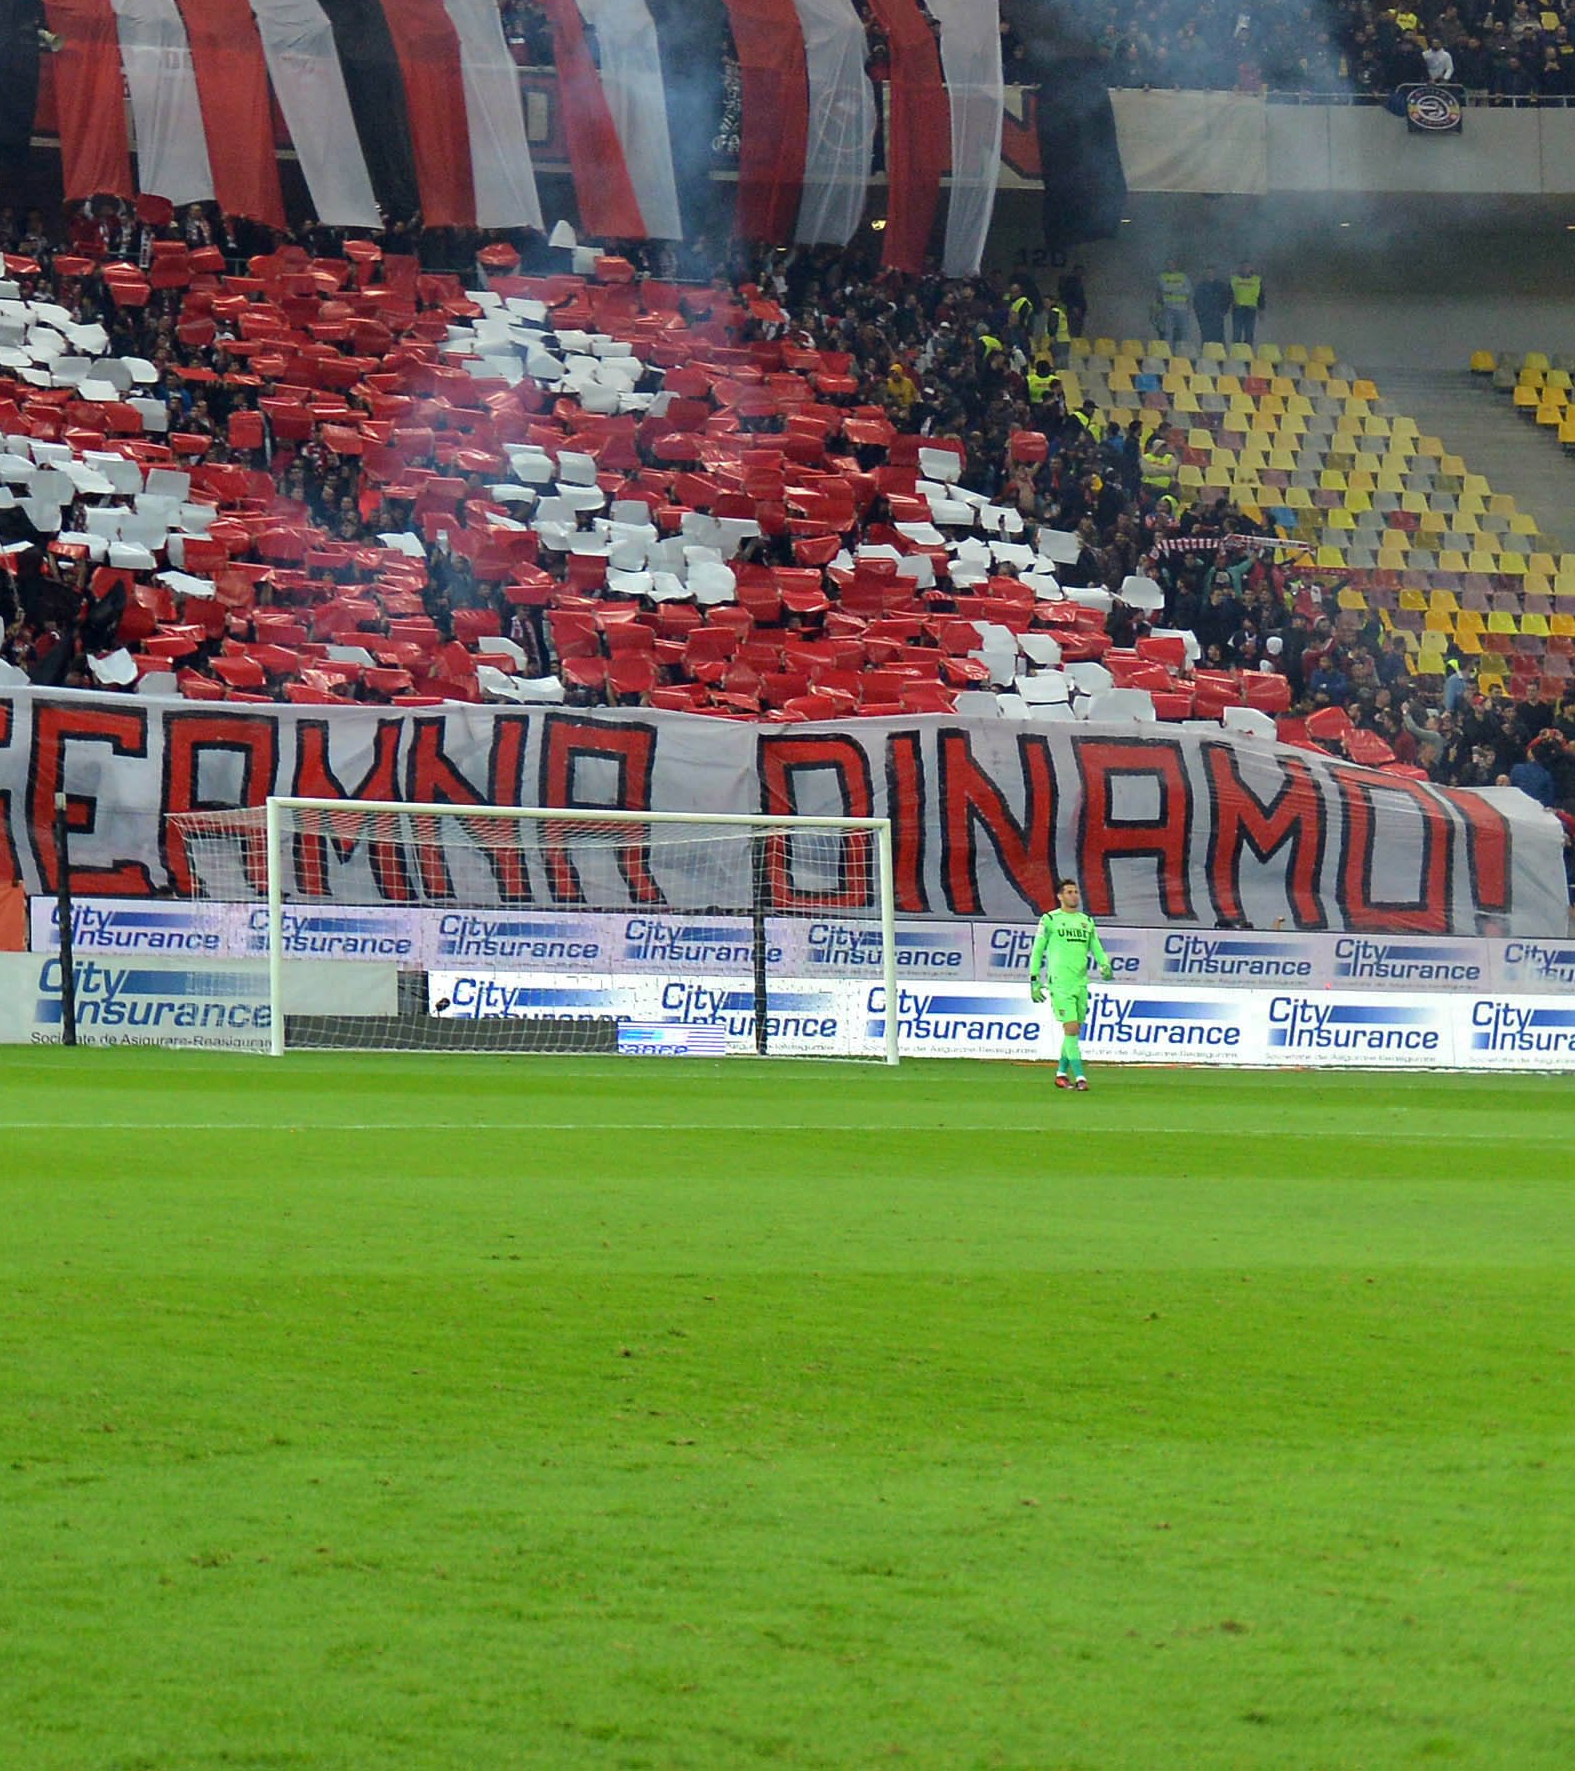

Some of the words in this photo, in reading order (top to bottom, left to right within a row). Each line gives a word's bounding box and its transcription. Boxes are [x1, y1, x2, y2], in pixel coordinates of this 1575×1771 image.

[757, 726, 1513, 935] DINAMO!
[250, 909, 308, 936] Cty
[440, 914, 499, 942] City
[625, 919, 683, 947] City
[279, 935, 412, 955] nsurance
[456, 937, 599, 959] Insurance
[808, 924, 864, 950] City
[991, 928, 1035, 952] Cit
[1164, 934, 1219, 963] City
[640, 942, 782, 963] Insurane
[825, 947, 962, 967] Insuance
[1335, 939, 1388, 967] City
[1181, 957, 1312, 976] Insurance
[1351, 962, 1481, 980] Insurance
[452, 977, 519, 1016] City
[662, 982, 728, 1020] City
[867, 987, 931, 1022] Cty
[1086, 993, 1134, 1026] ity
[73, 999, 272, 1027] nsurance
[1269, 997, 1330, 1031] City
[1472, 1001, 1532, 1033] City
[897, 1019, 1040, 1040] nsurance
[1088, 1022, 1240, 1045] Insurance
[1288, 1027, 1439, 1049] Insurance
